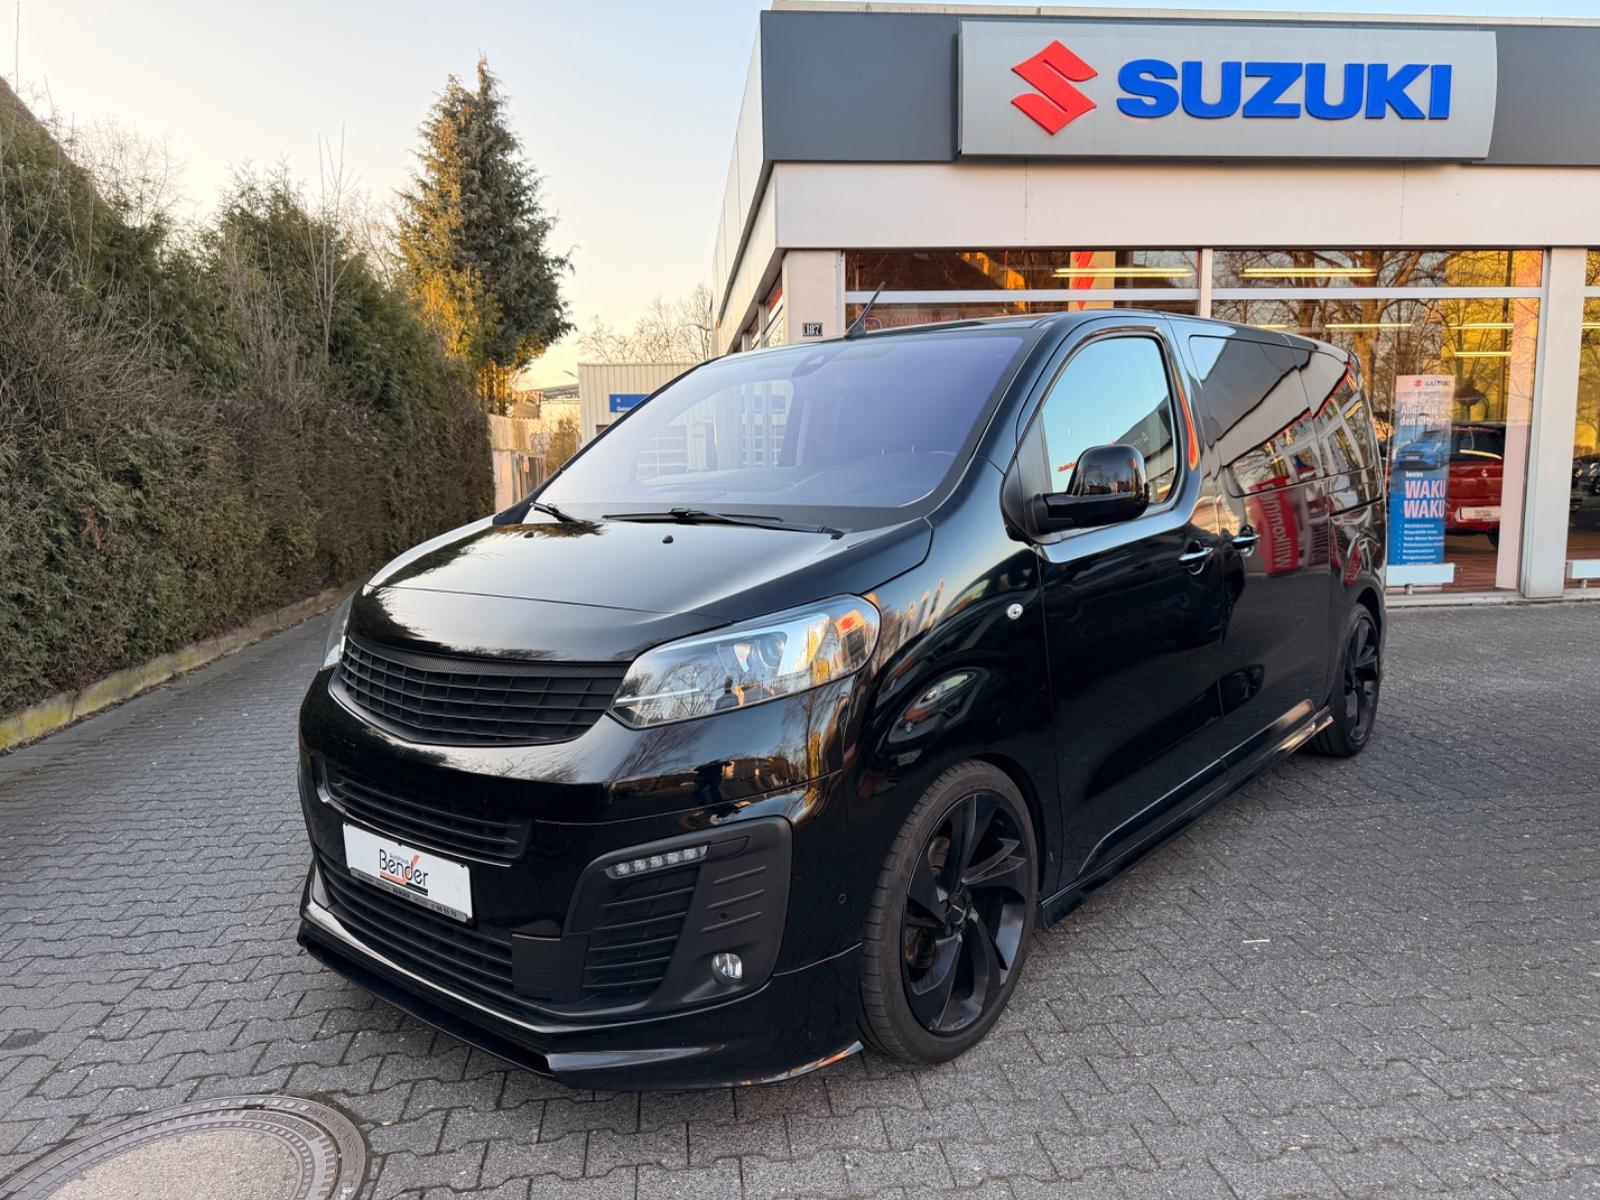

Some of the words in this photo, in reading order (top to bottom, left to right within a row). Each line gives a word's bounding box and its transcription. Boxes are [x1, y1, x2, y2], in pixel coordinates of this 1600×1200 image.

[1116, 58, 1453, 121] SUZUKI
[1404, 480, 1447, 499] WAKU
[1403, 500, 1445, 519] WAKU
[379, 848, 429, 887] Bender
